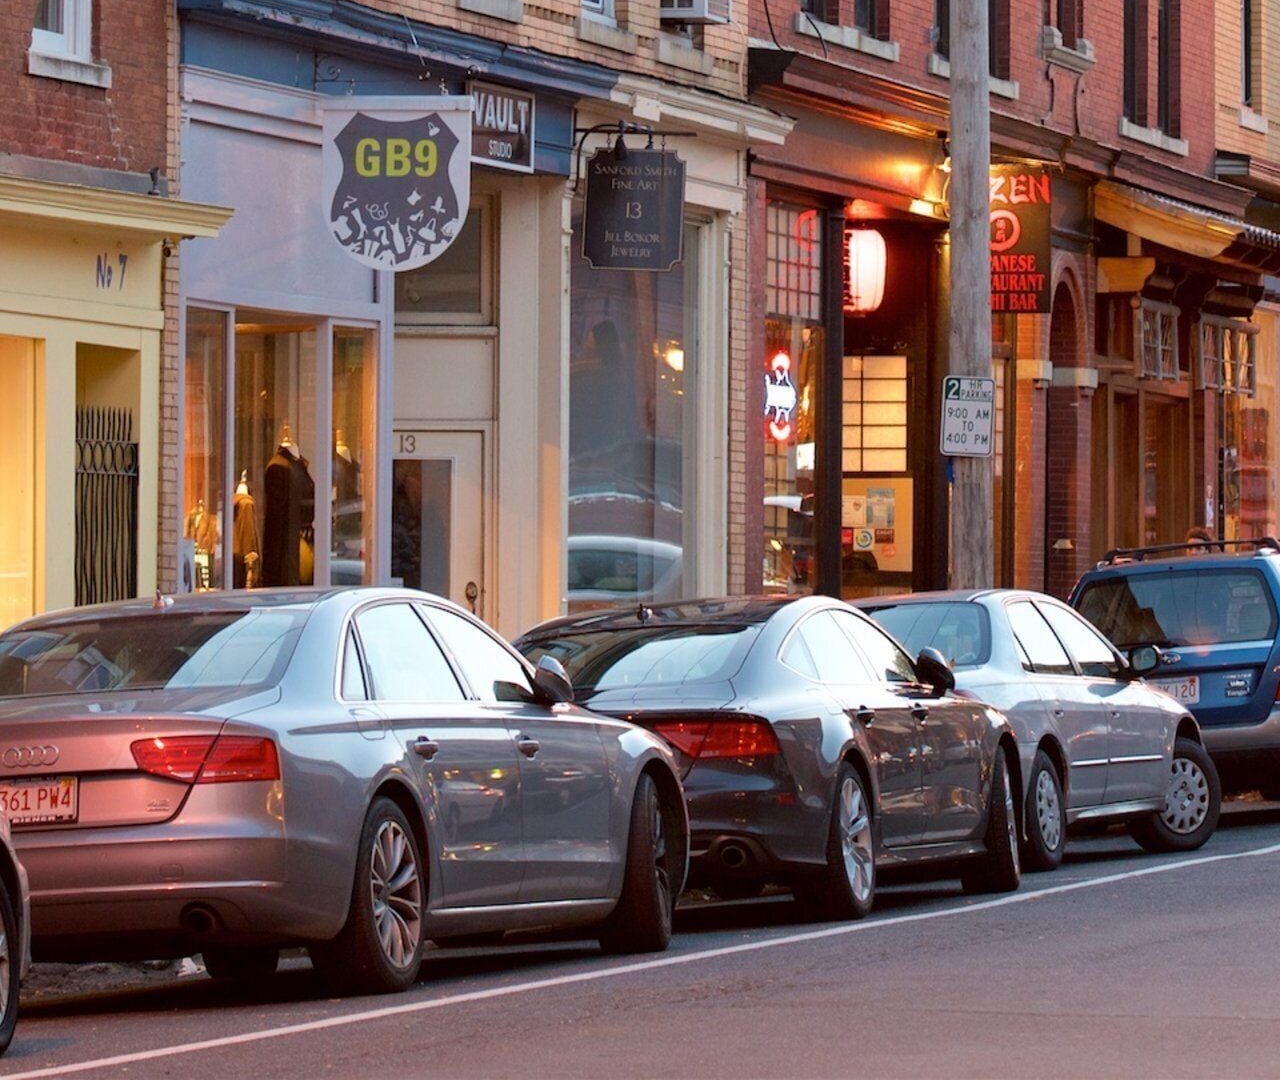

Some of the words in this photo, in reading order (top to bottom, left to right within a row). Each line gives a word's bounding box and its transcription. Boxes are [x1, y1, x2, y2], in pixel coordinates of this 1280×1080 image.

[473, 91, 529, 134] VAULT
[355, 138, 438, 178] GB9
[488, 139, 513, 159] STUDIO
[989, 174, 1051, 204] ZEN
[626, 202, 642, 219] 13
[96, 252, 112, 289] No
[118, 253, 128, 291] 7
[990, 255, 1036, 272] ANESE
[990, 274, 1045, 291] AURANT
[990, 293, 1005, 310] HI
[1009, 293, 1037, 310] BAR
[948, 380, 959, 398] 2
[975, 409, 990, 419] AM
[962, 420, 974, 432] TO
[399, 434, 416, 454] 13
[974, 433, 988, 445] PM
[37, 786, 71, 810] PW4
